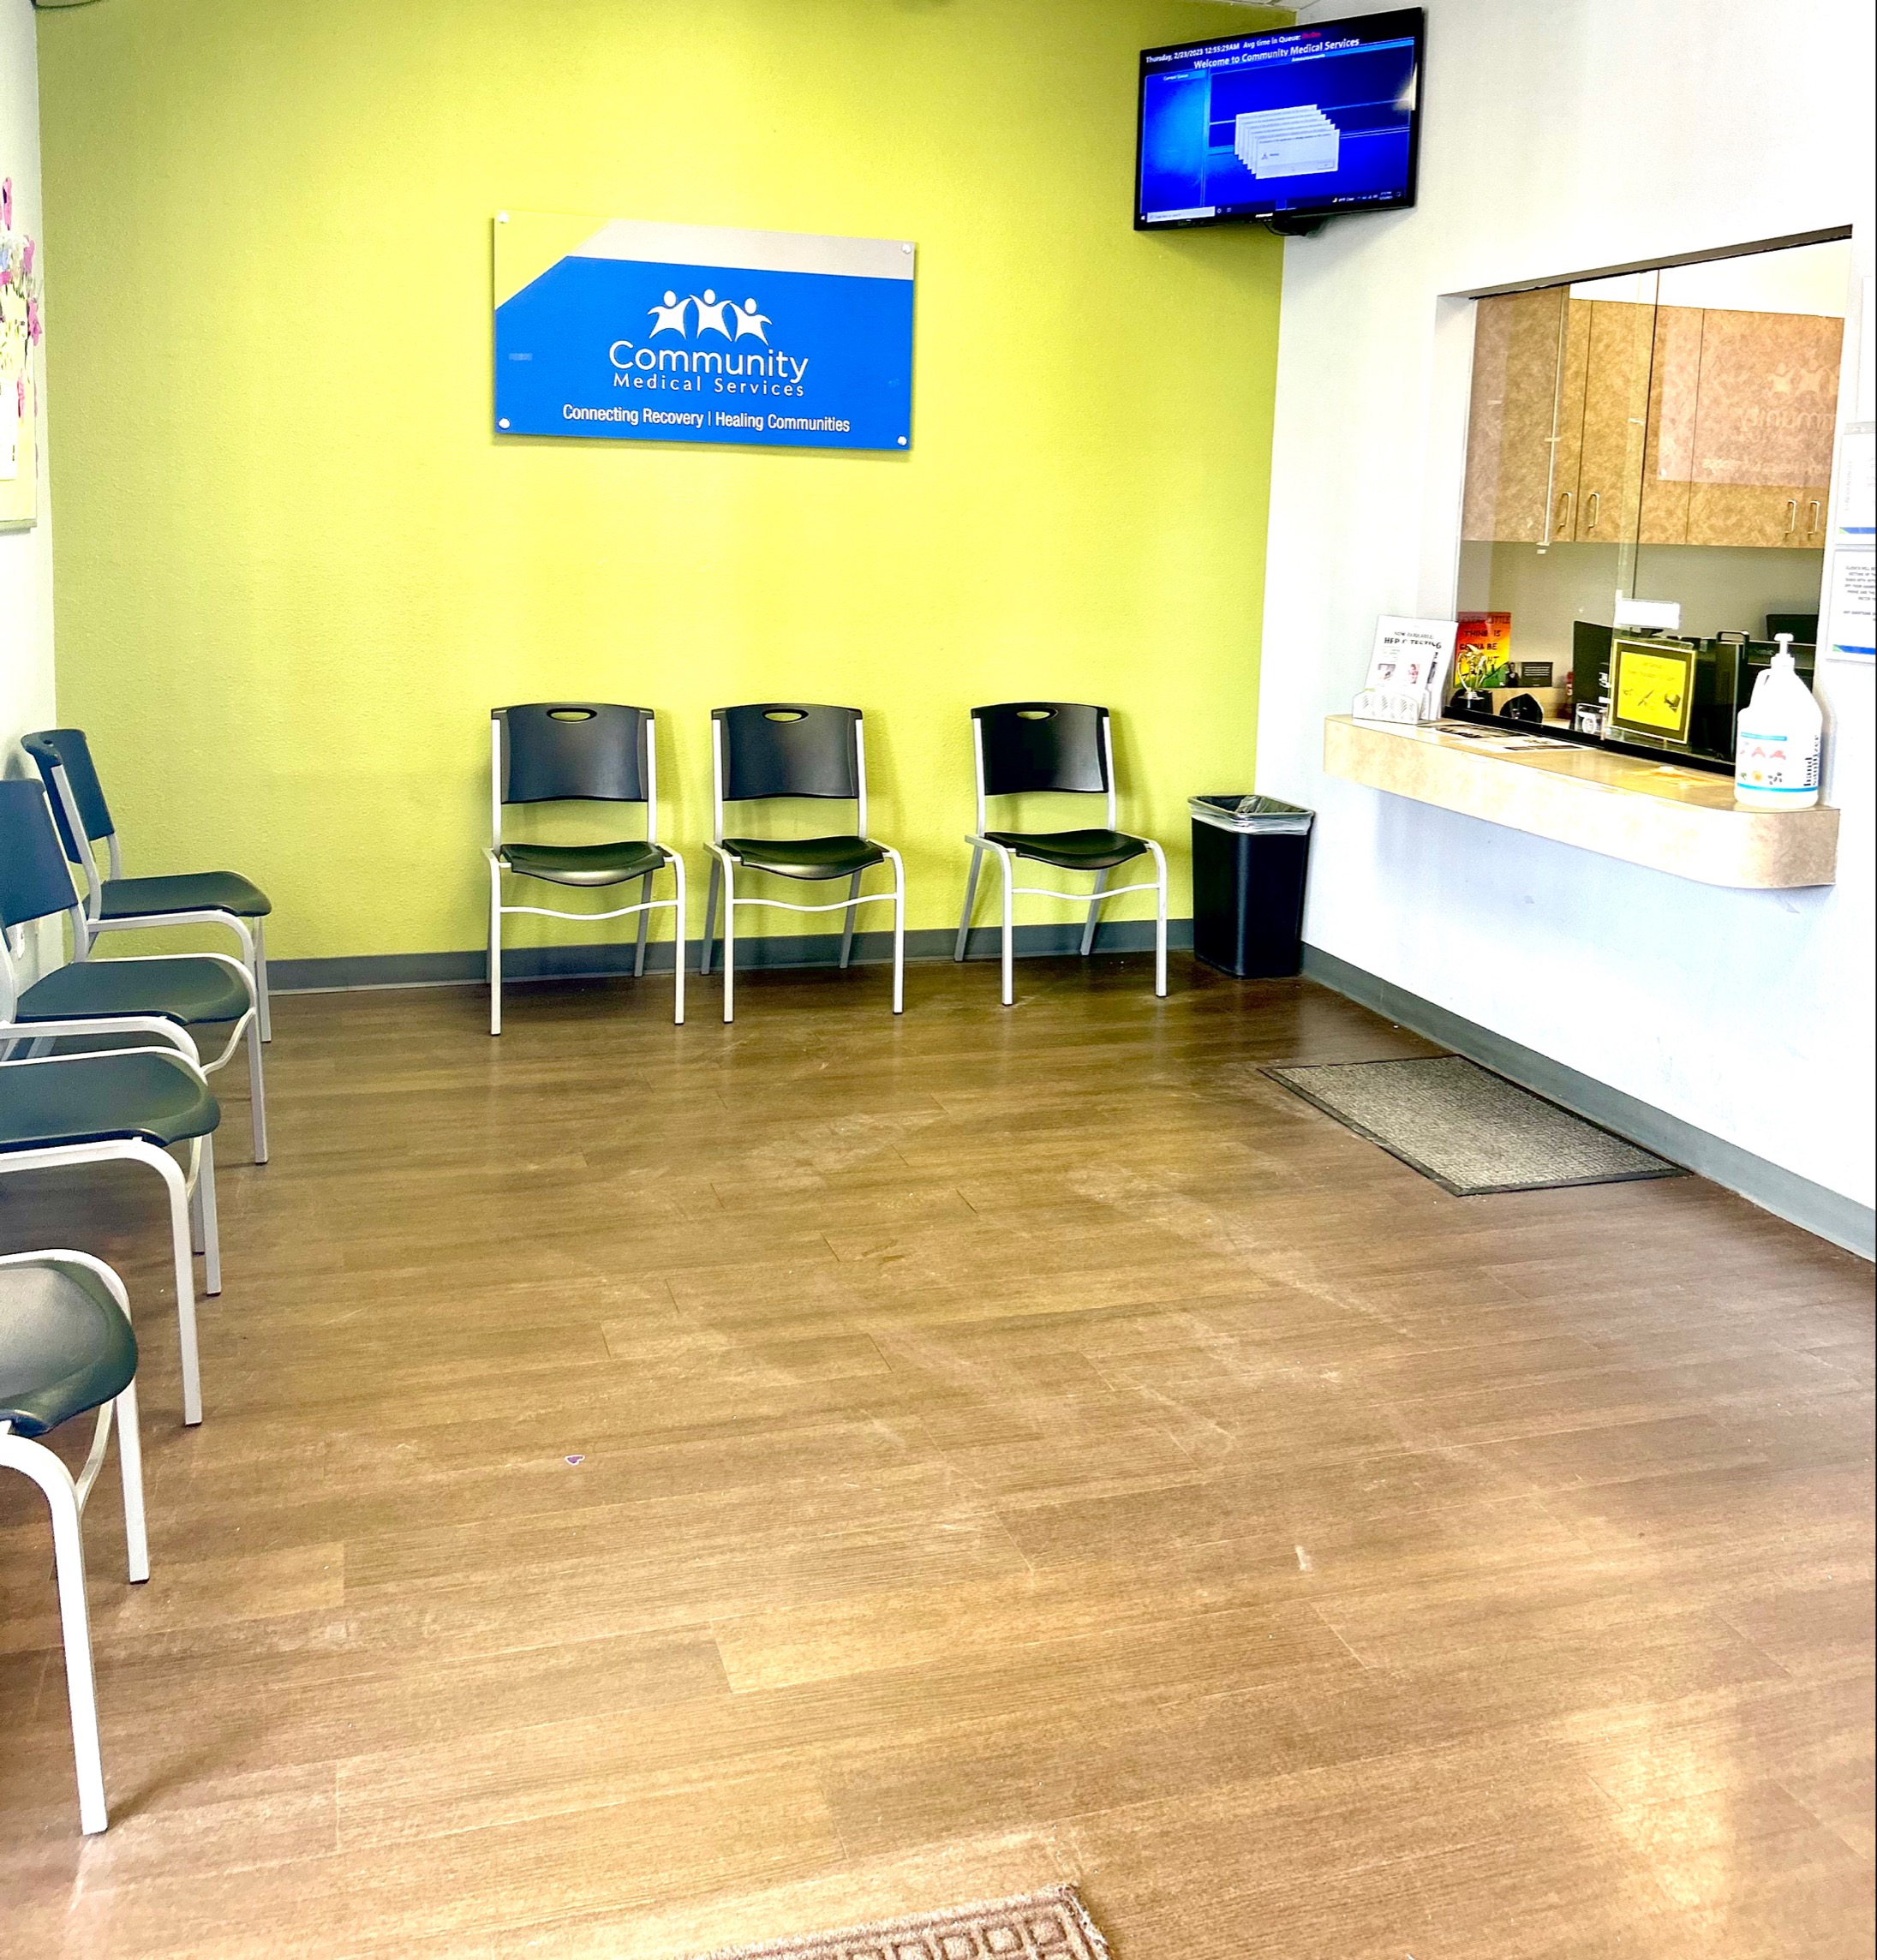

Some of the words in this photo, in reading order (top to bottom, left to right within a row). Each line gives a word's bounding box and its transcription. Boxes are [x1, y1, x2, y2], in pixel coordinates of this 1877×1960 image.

[1145, 53, 1173, 63] Thursday,
[1242, 40, 1255, 49] Avg
[1256, 38, 1270, 47] time
[1278, 34, 1301, 44] Queue:
[1193, 57, 1229, 69] Welcome
[1231, 56, 1240, 64] to
[1241, 48, 1288, 63] Community
[1290, 42, 1323, 56] Medical
[1324, 39, 1360, 51] Services
[609, 339, 810, 385] Community
[613, 372, 701, 391] Medical
[714, 377, 804, 397] Services
[562, 403, 639, 426] Connecting
[643, 407, 704, 429] Recovery
[715, 411, 764, 432] Healing
[768, 414, 851, 433] Communities
[1802, 756, 1813, 786] hand
